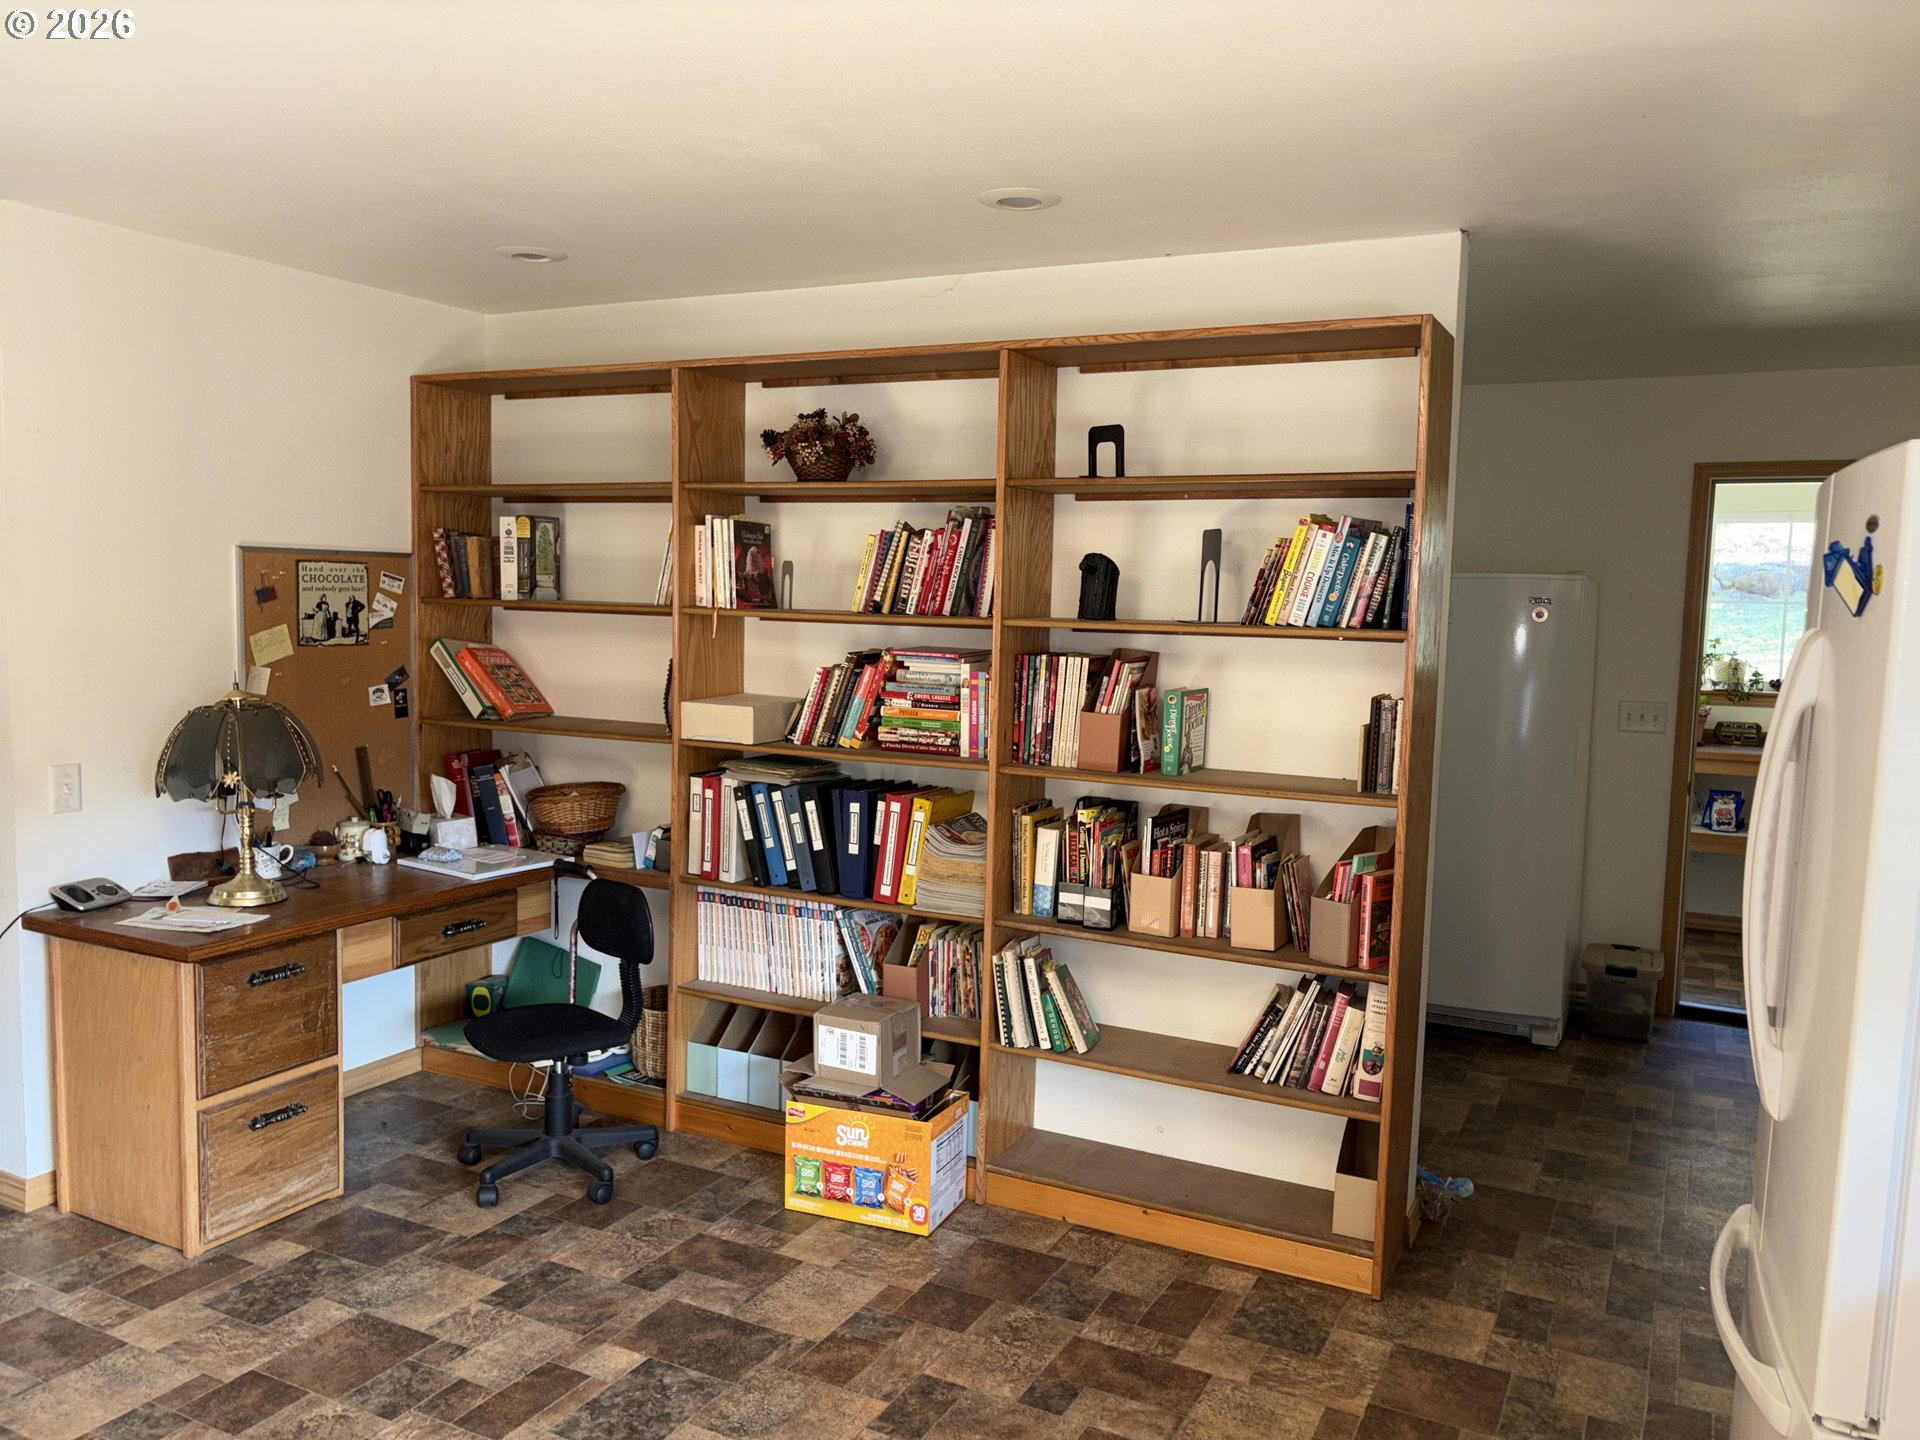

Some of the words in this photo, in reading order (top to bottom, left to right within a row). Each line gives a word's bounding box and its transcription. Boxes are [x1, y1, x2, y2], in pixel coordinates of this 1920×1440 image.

[965, 532, 976, 558] DOWNTON
[1330, 544, 1339, 558] Mix
[301, 565, 324, 573] Hand
[302, 573, 365, 584] CHOCOLATE
[1323, 564, 1333, 575] Up
[315, 585, 337, 593] nobody
[947, 579, 956, 601] KITCHEN
[1277, 569, 1292, 593] Bisquick
[1300, 570, 1315, 598] COOKIE
[1315, 575, 1329, 603] Desserts
[1186, 700, 1205, 720] Dinner
[1170, 709, 1178, 734] Dinner
[1154, 827, 1165, 840] Hot
[1170, 821, 1186, 836] Spicy
[1028, 978, 1037, 996] great
[836, 1124, 869, 1146] Sun
[848, 1140, 868, 1148] CHIPS
[912, 1205, 925, 1218] 30
